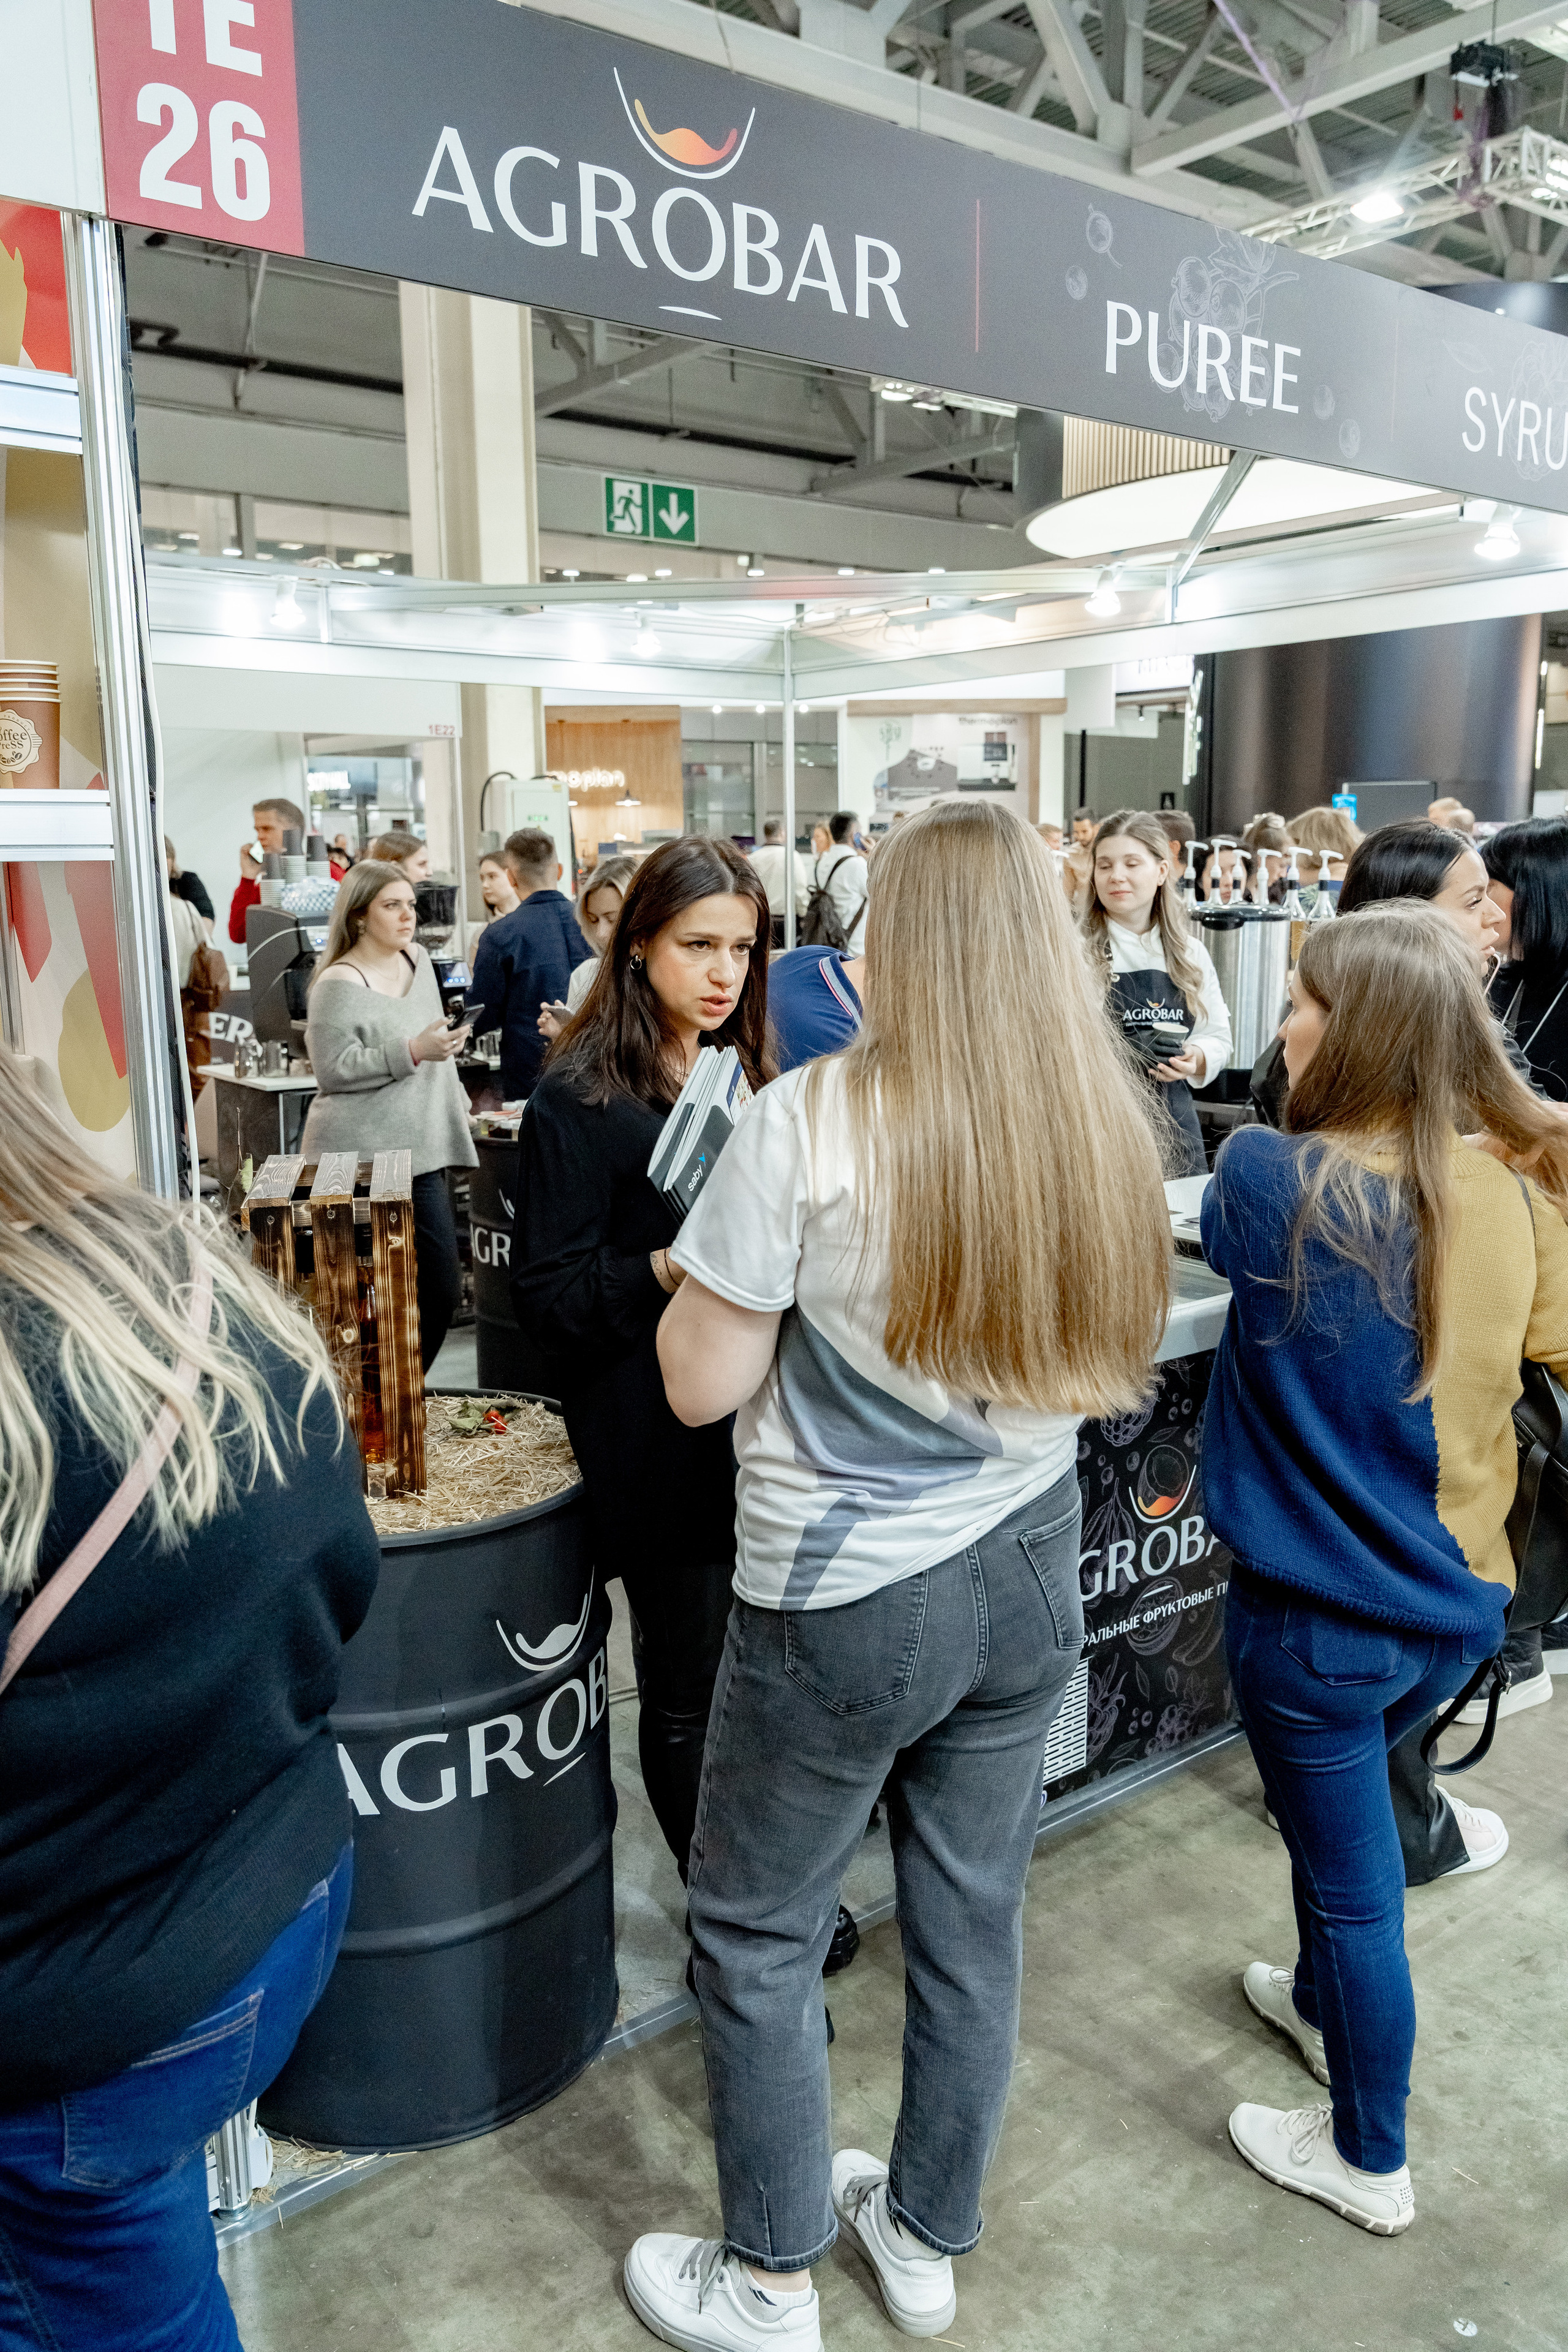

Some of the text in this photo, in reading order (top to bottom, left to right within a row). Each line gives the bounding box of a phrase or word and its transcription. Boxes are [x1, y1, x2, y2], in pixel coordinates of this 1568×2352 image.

[137, 82, 271, 222] 26
[412, 126, 910, 328] AGROBAR
[1105, 300, 1301, 415] PUREE
[1461, 386, 1568, 471] SYRU
[429, 725, 454, 735] 1E22
[1123, 1008, 1183, 1021] AGROBAR
[688, 1164, 703, 1192] saby
[1143, 1586, 1215, 1623] ФРУКТОВЫЕ
